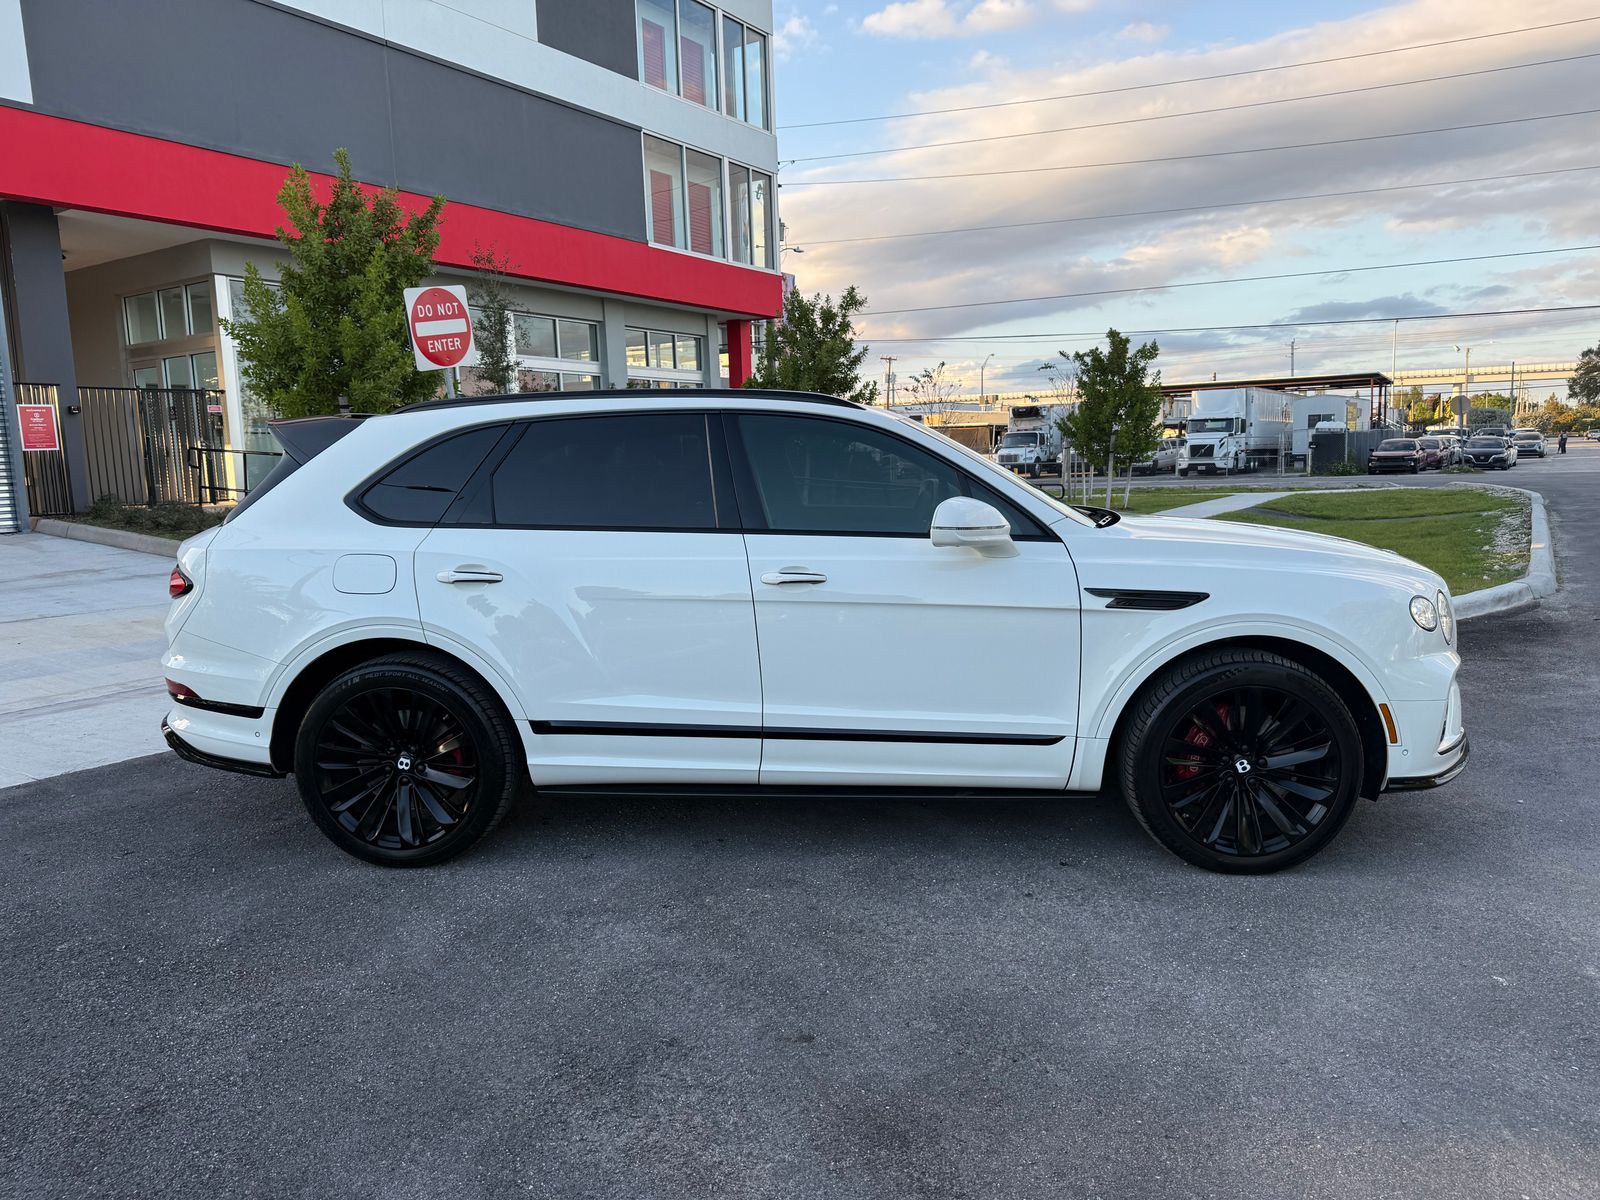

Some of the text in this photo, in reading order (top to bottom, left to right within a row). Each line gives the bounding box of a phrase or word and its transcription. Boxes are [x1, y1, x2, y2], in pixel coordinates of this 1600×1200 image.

[417, 302, 459, 317] DO NOT
[427, 337, 462, 353] ENTER
[365, 671, 384, 679] PILOT
[421, 676, 445, 691] SEASON
